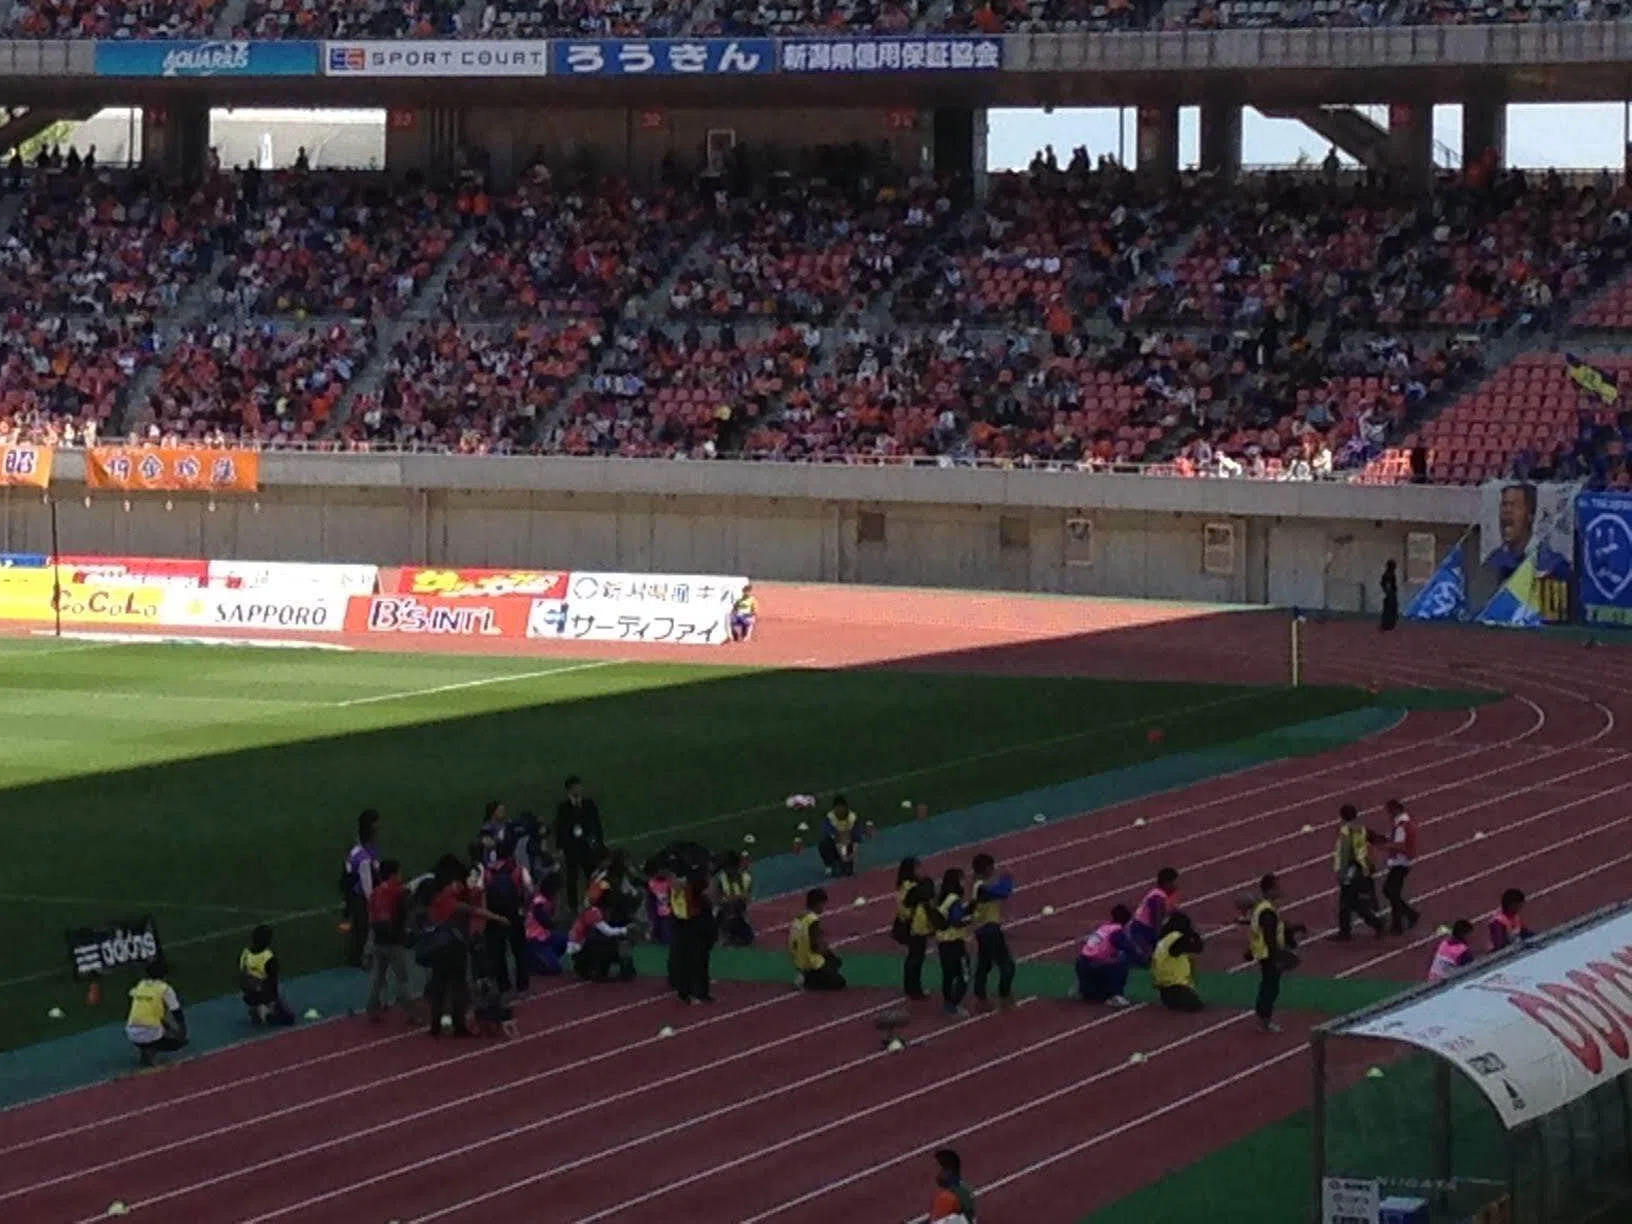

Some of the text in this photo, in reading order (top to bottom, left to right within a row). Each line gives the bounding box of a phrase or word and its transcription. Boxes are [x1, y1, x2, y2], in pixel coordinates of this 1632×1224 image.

[372, 51, 543, 66] SPORT COURT
[567, 43, 760, 73] ろうきん
[783, 41, 999, 71] 新潟県信用保証協会
[215, 603, 327, 626] SAPPORO
[571, 615, 718, 642] サーティファイ
